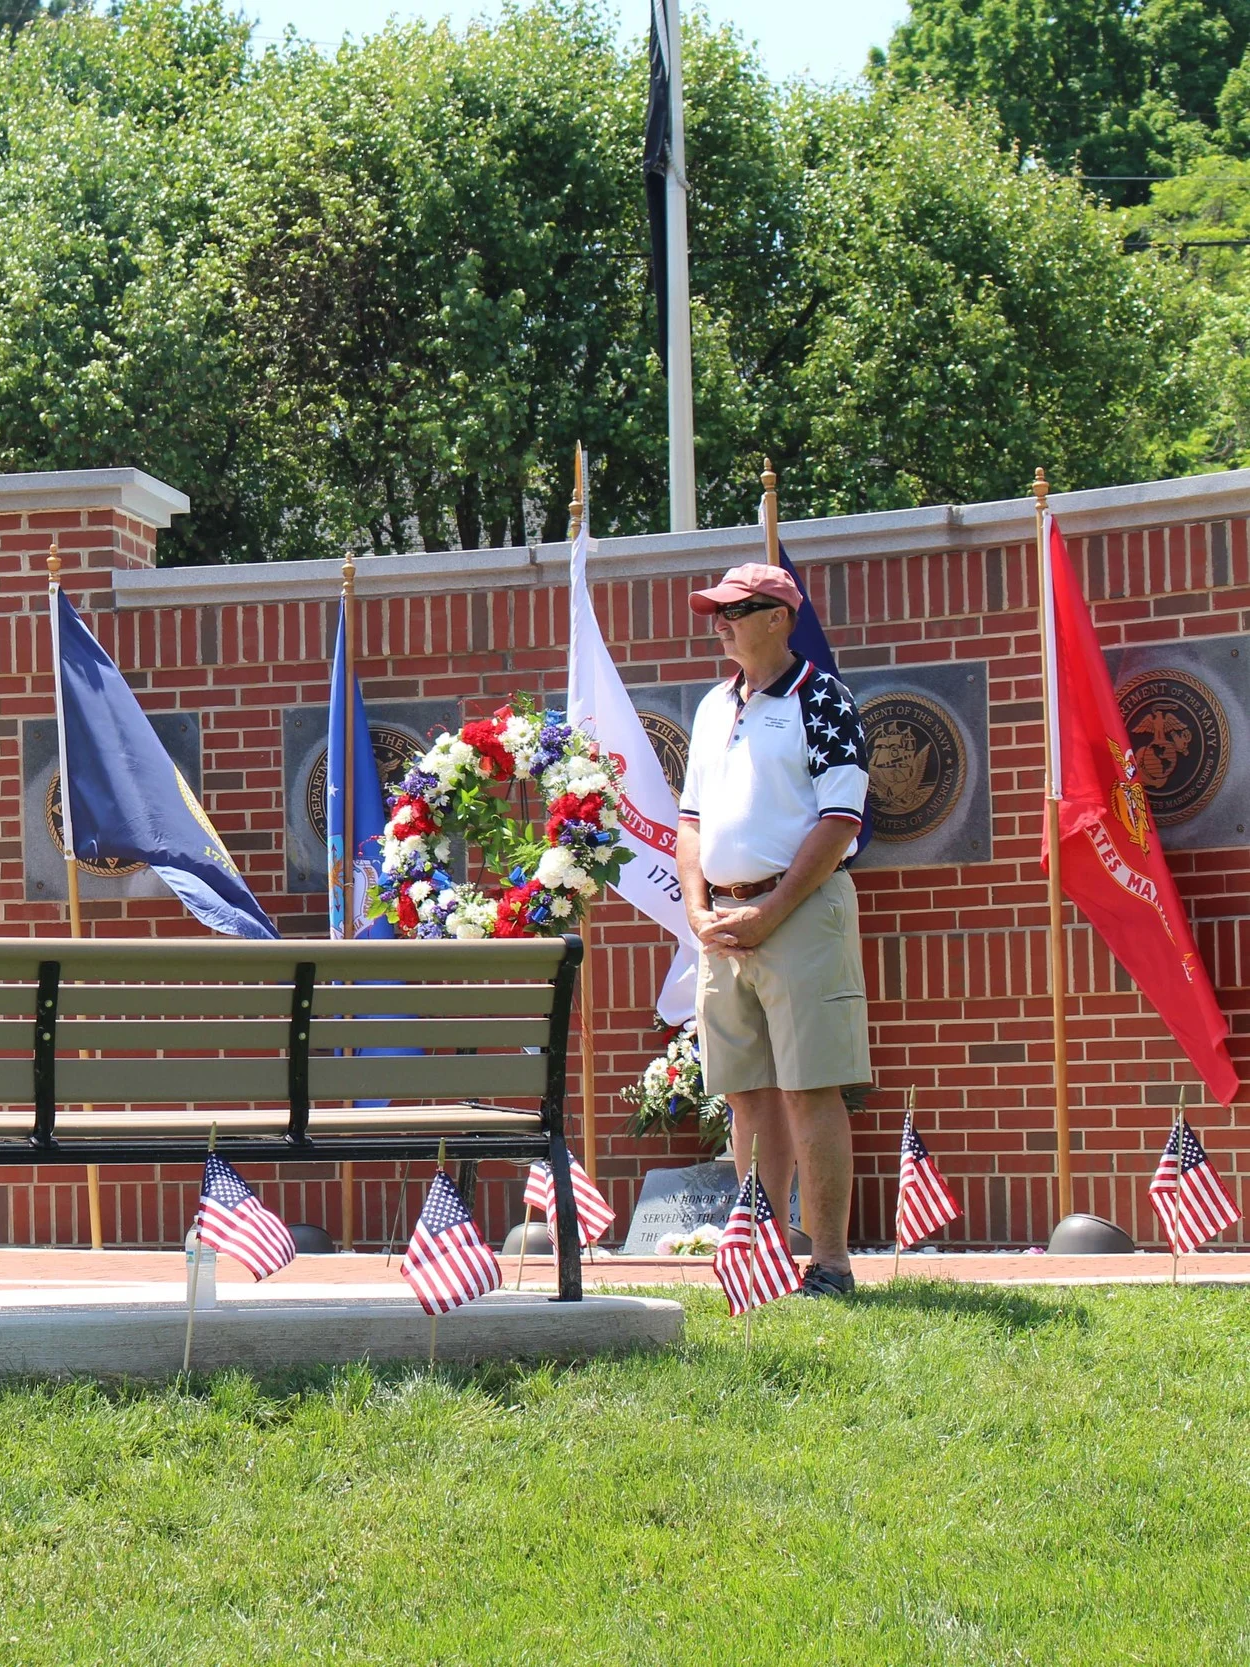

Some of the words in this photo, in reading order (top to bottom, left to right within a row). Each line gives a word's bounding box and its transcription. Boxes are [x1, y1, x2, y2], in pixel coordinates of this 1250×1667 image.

[655, 721, 677, 741] THE
[896, 706, 911, 715] OF
[913, 709, 934, 726] THE
[932, 723, 952, 753] NAVY
[1171, 687, 1183, 696] OF
[1185, 694, 1200, 709] THE
[1199, 708, 1218, 748] NAVY
[378, 732, 404, 750] THE
[909, 813, 924, 826] OF
[926, 769, 955, 817] AMERICA
[1165, 787, 1197, 809] MARINE
[1196, 759, 1214, 789] CORPS
[619, 802, 654, 840] NITED
[647, 864, 683, 902] 1775
[667, 1194, 677, 1204] IN
[681, 1194, 716, 1204] HONOR
[720, 1194, 734, 1204] OF
[642, 1213, 682, 1224] SERVED
[697, 1213, 716, 1224] THE
